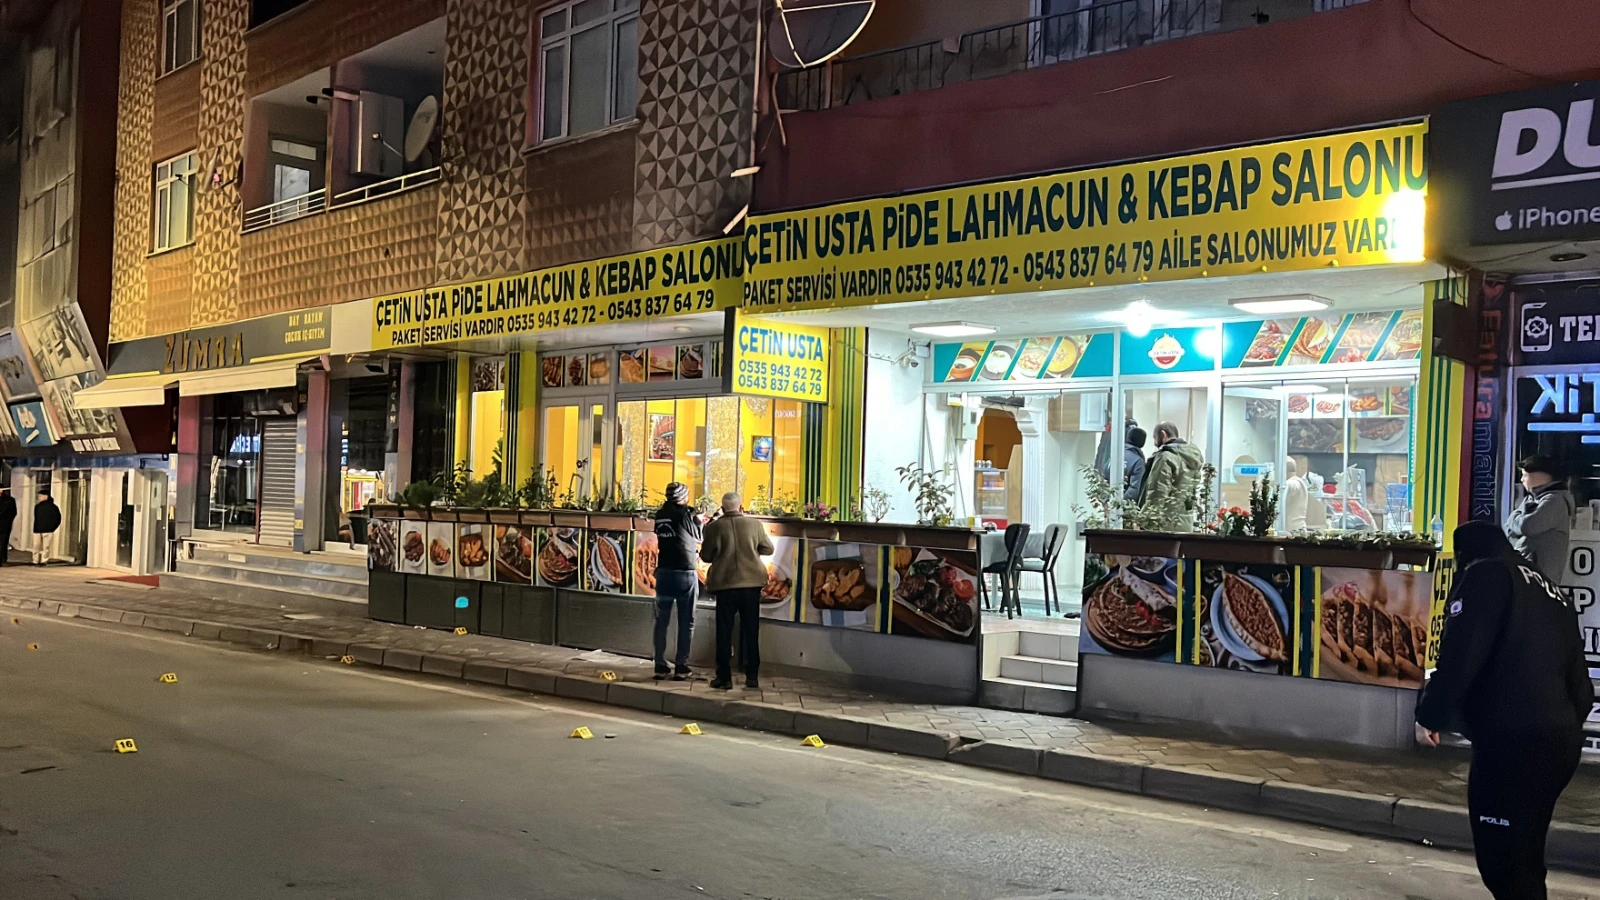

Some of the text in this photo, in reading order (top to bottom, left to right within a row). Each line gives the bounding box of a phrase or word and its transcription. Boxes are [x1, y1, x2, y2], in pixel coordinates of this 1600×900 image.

[815, 208, 875, 258] USTA
[946, 176, 1108, 244] LAHMACUN
[1117, 172, 1138, 223] &
[1148, 156, 1261, 220] KEBAP
[1271, 132, 1428, 206] SALONU
[1518, 206, 1600, 230] iPhone
[743, 280, 784, 307] PAKET
[787, 266, 836, 303] SERVİSİ
[840, 267, 891, 299] VARDIR
[896, 262, 931, 294] 0535
[935, 259, 964, 290] 943
[967, 256, 986, 287] 42
[991, 254, 1009, 285] 72
[1024, 250, 1065, 283] 0543
[1070, 245, 1099, 279] 837
[1104, 243, 1126, 275] 64
[1132, 240, 1153, 272] 79
[1159, 229, 1201, 271] AİLE
[1207, 221, 1337, 266] SALONUMUZ
[415, 291, 448, 322] USTA
[487, 269, 575, 312] LAHMACUN
[579, 267, 591, 299] &
[596, 256, 657, 297] KEBAP
[661, 242, 744, 288] SALONU
[391, 328, 421, 345] PAKET
[424, 318, 462, 342] SERVİSİ
[465, 317, 504, 338] VARDIR
[507, 313, 534, 332] 0535
[538, 310, 559, 329] 943
[563, 307, 578, 325] 42
[582, 305, 596, 324] 72
[608, 301, 641, 320] 0543
[645, 295, 669, 316] 837
[673, 292, 692, 312] 64
[697, 289, 714, 309] 79
[787, 333, 823, 361] USTA
[739, 359, 822, 381] 0535 943 42 72
[738, 374, 821, 395] 0543 837 64 79
[120, 741, 133, 749] 16
